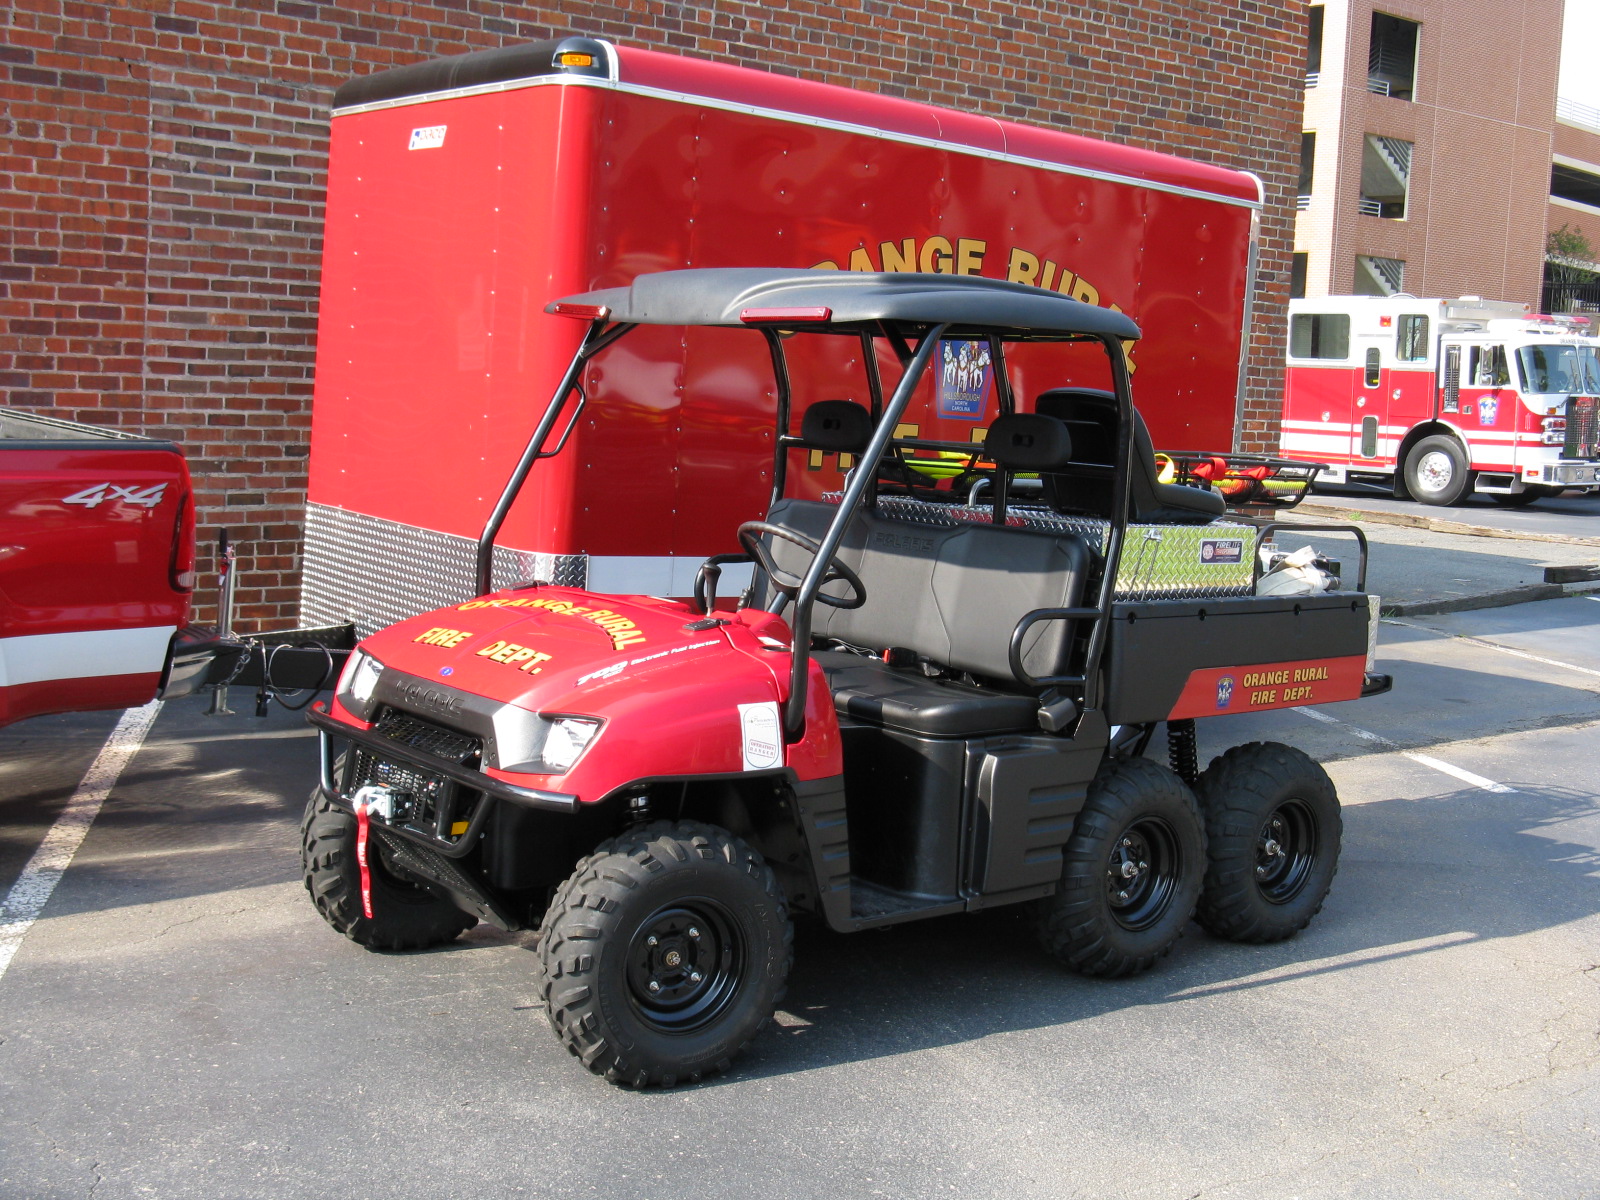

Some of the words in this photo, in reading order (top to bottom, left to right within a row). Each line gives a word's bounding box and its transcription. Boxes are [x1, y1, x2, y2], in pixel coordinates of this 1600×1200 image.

[943, 392, 980, 401] HILLSBOROUGH
[874, 531, 935, 552] POLARIS
[456, 598, 591, 616] ORANGE
[582, 609, 646, 651] RURAL
[412, 627, 474, 648] FIRE
[475, 640, 553, 675] DEPT.
[1243, 670, 1289, 688] ORANGE
[1293, 666, 1329, 682] RURAL
[1250, 689, 1277, 705] FIRE
[1283, 686, 1313, 702] DEPT.
